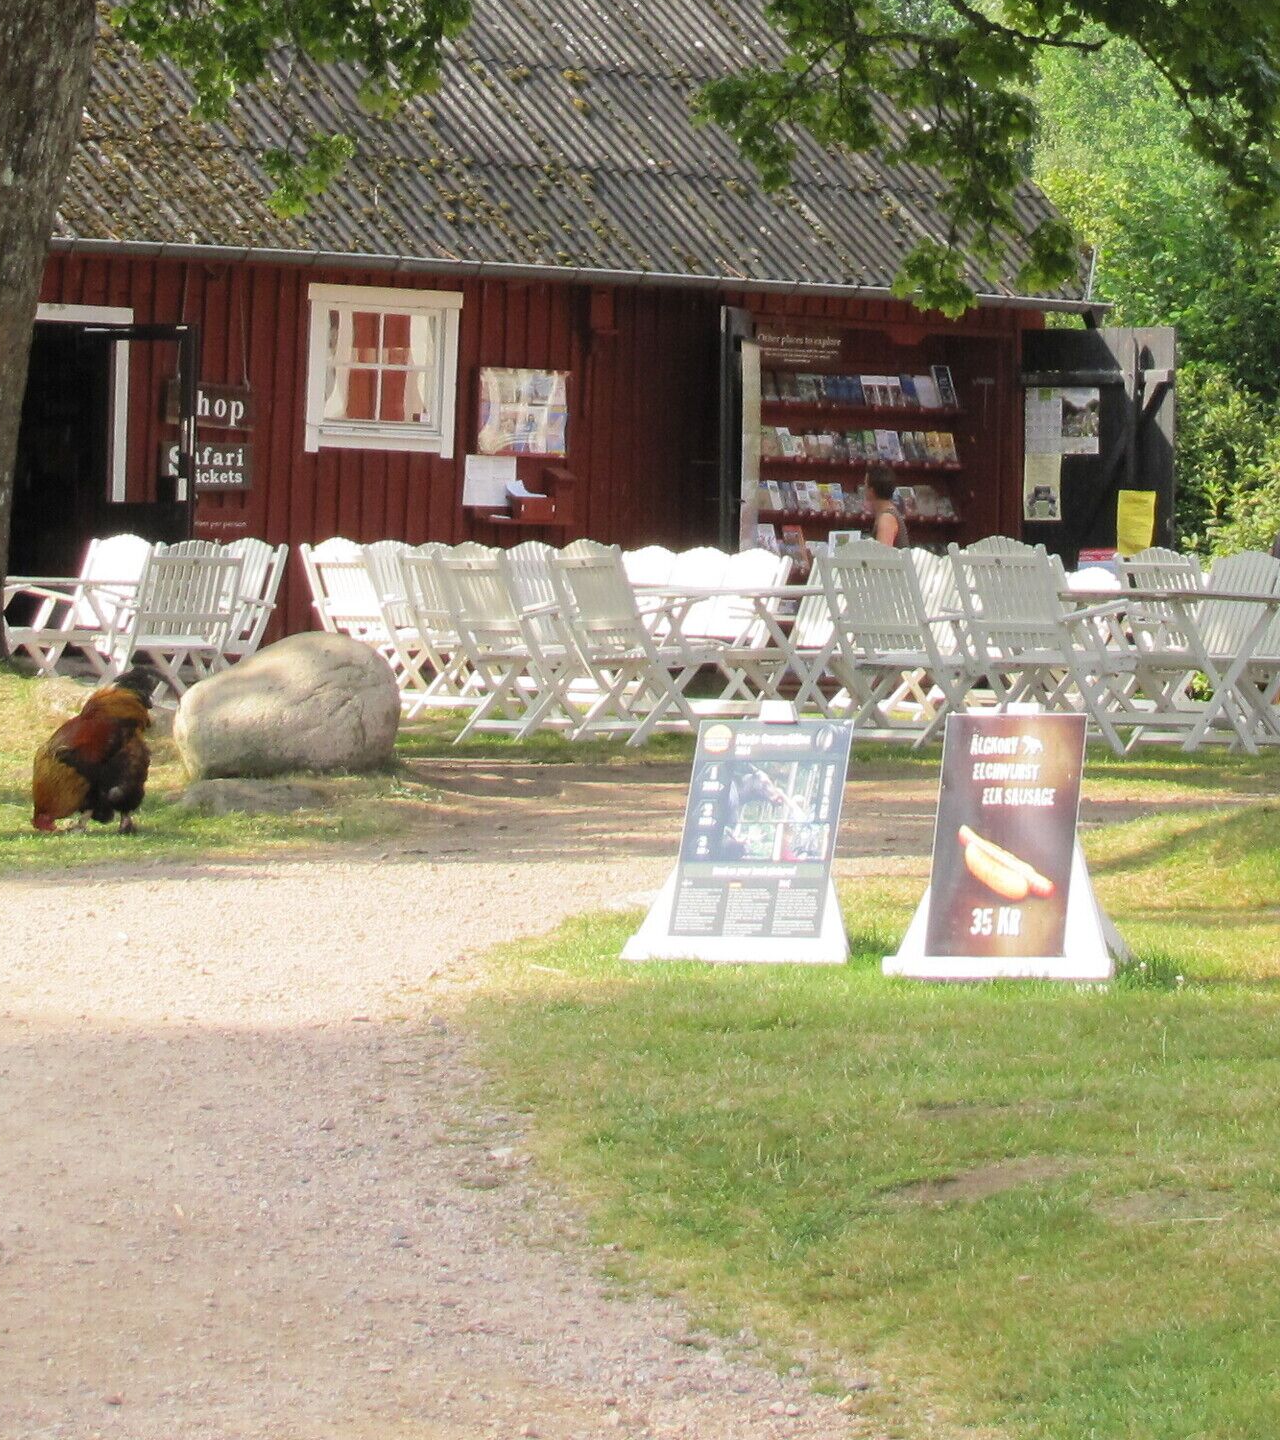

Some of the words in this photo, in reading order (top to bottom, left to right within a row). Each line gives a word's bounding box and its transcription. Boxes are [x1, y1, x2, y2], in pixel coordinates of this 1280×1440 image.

[197, 390, 244, 426] hop
[195, 468, 242, 483] ickets
[982, 787, 1004, 805] ELK
[1004, 787, 1056, 806] SAUSAGE
[970, 907, 993, 935] 35
[997, 906, 1021, 936] KR
